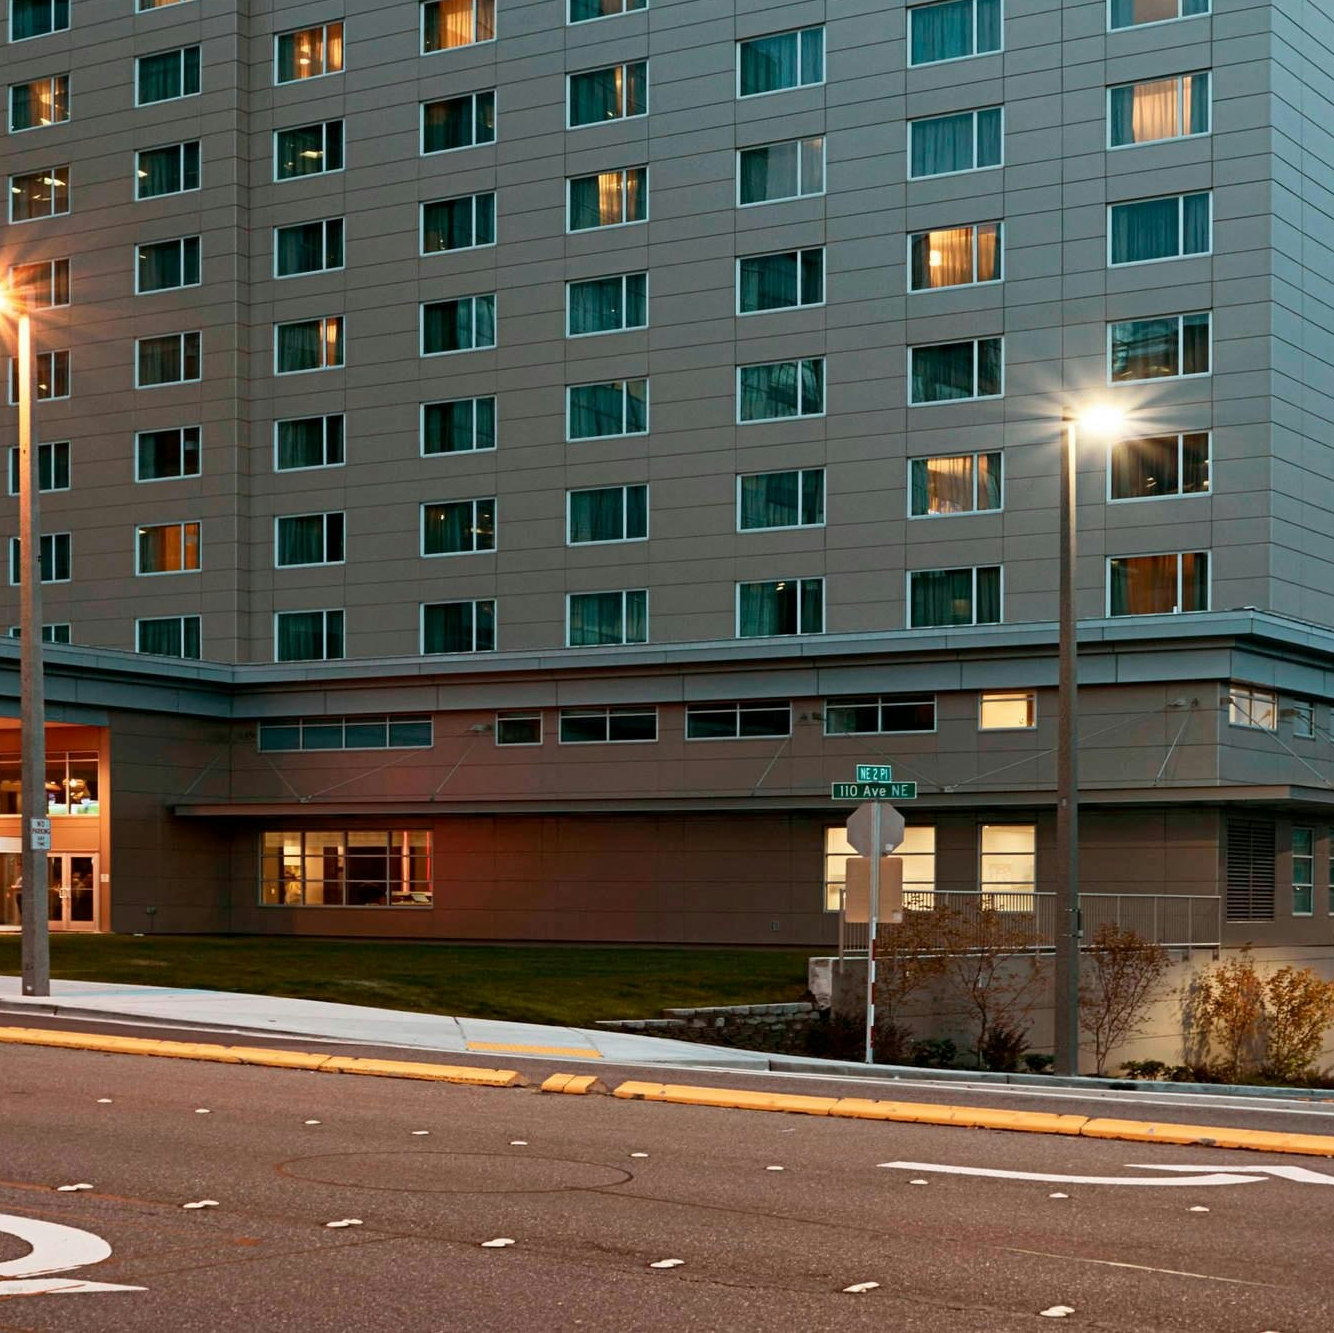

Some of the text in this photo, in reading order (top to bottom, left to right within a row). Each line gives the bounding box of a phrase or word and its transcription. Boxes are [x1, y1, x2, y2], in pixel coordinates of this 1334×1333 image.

[860, 767, 871, 780] NE
[872, 768, 878, 780] 2
[840, 784, 909, 797] 110 Ave NE
